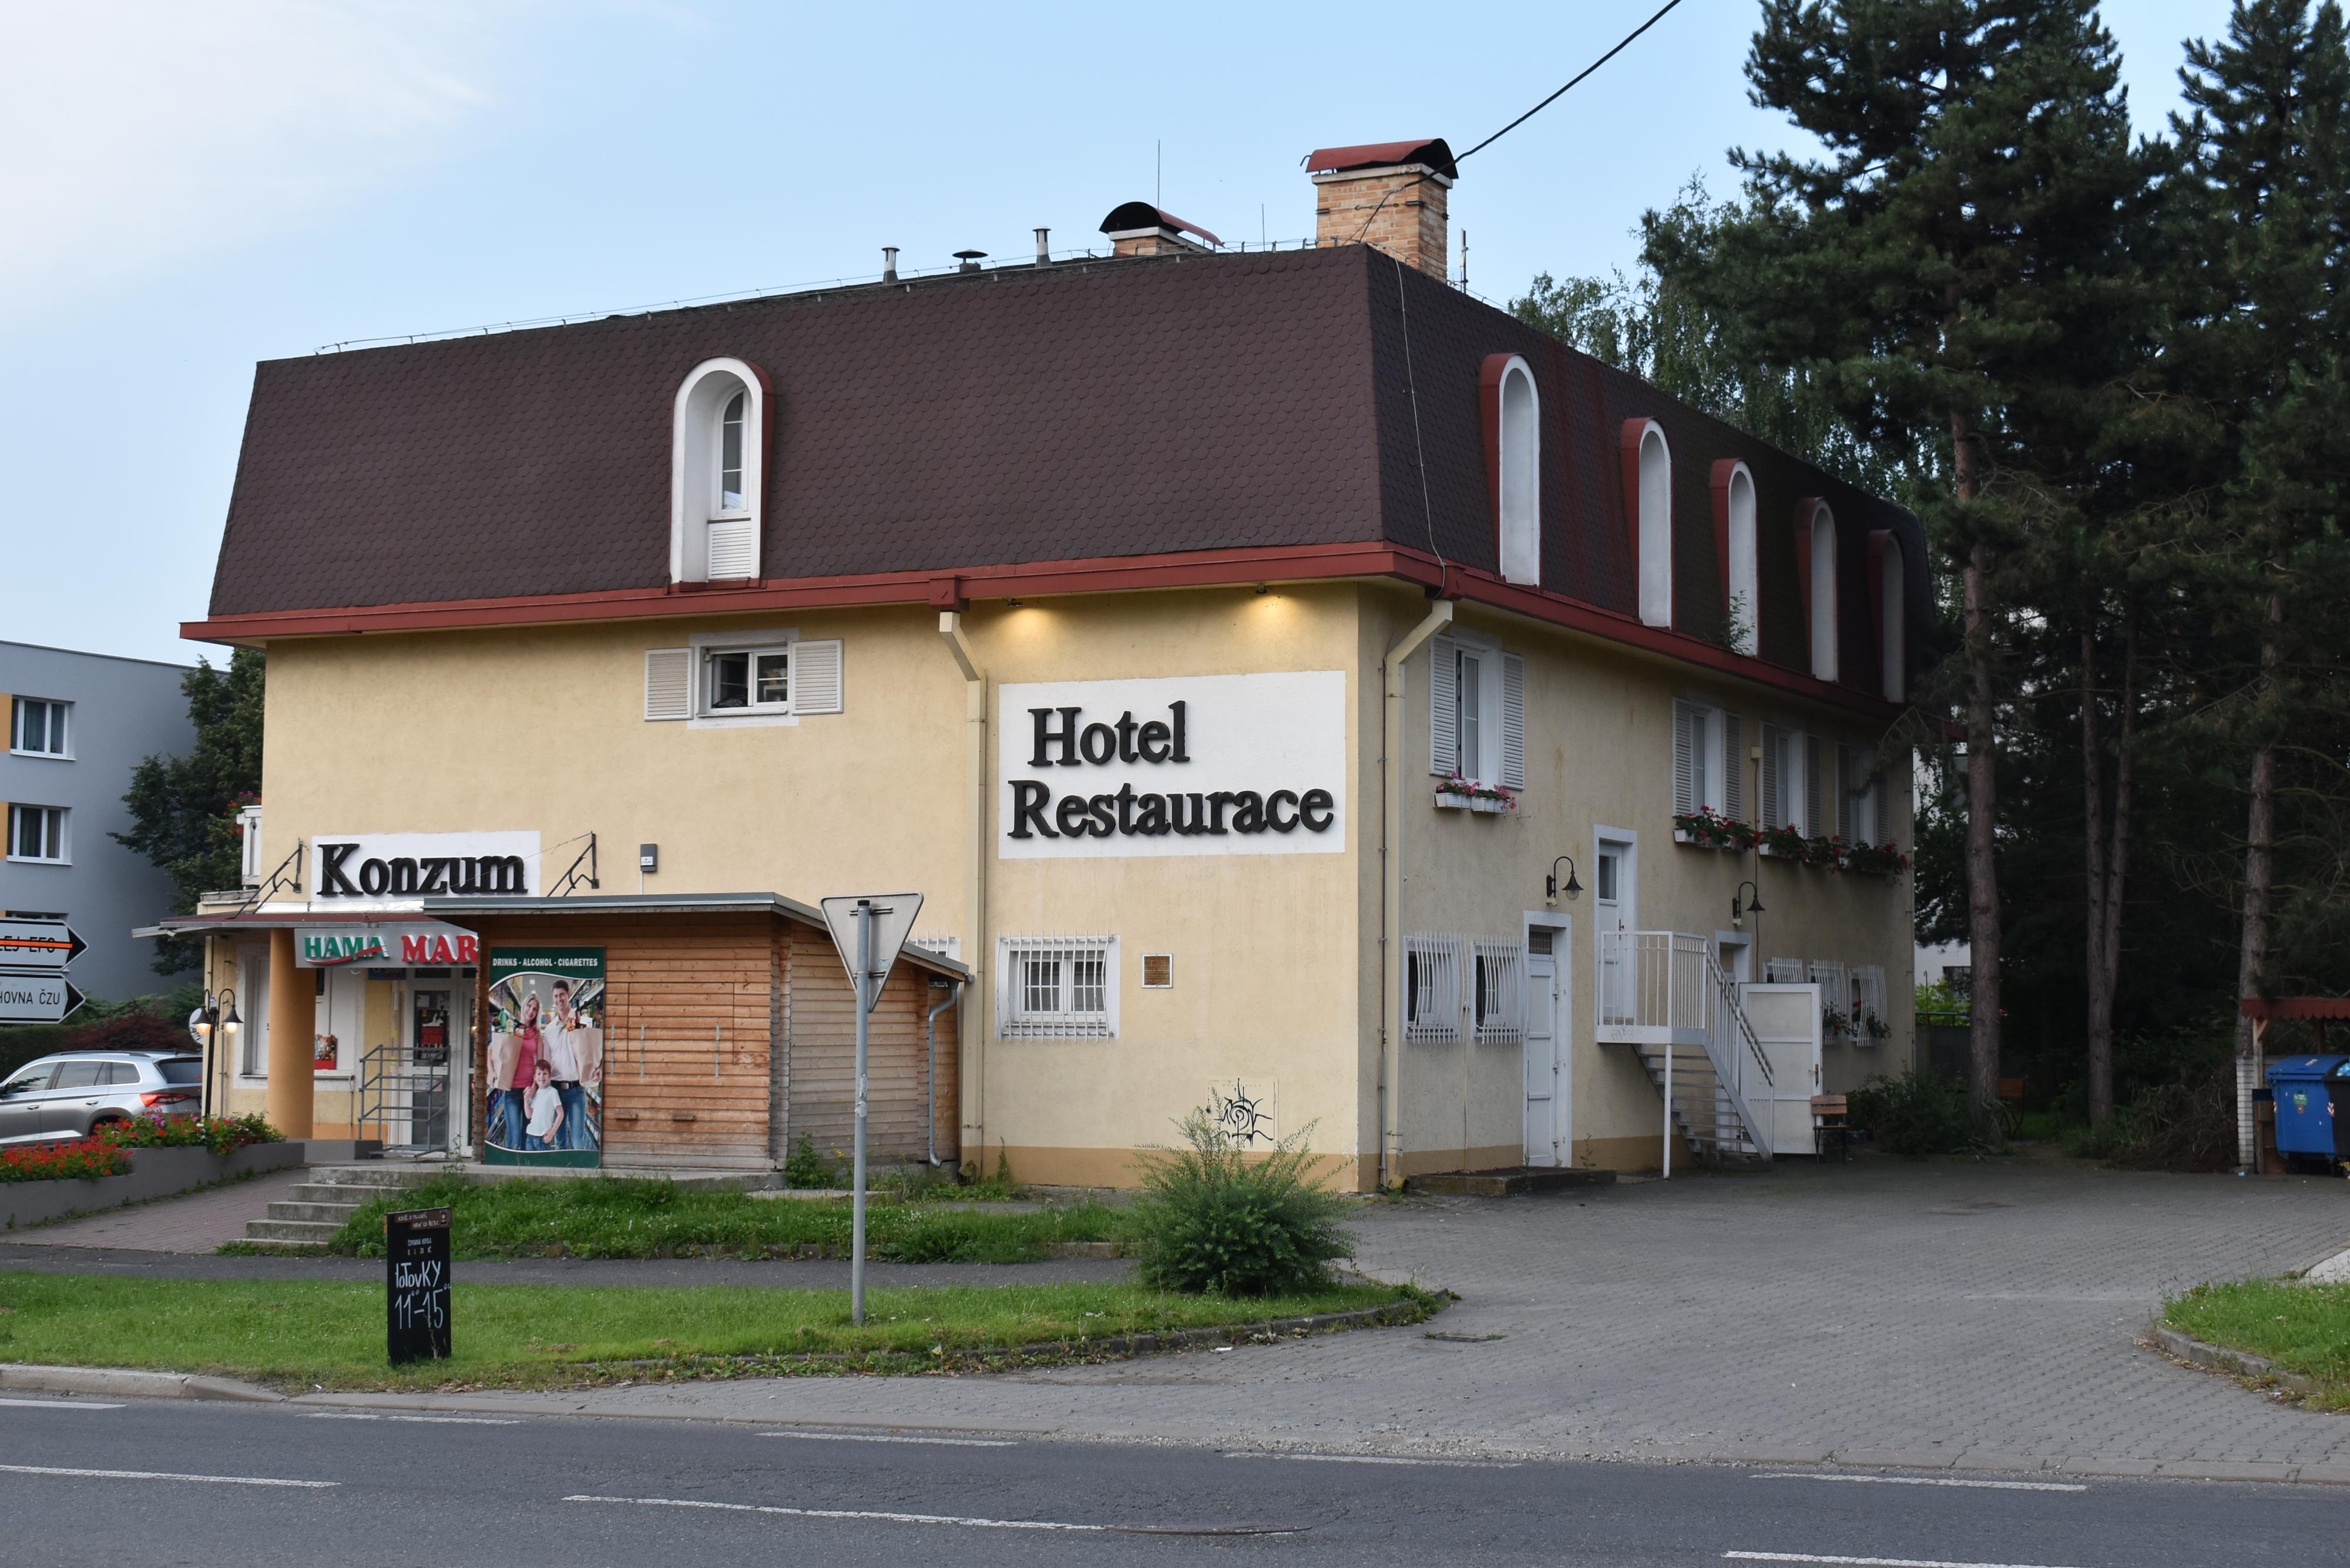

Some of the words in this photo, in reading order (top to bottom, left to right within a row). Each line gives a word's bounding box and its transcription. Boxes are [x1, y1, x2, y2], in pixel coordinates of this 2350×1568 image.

[1028, 700, 1191, 766] Hotel
[1007, 780, 1334, 839] Restaurace
[317, 843, 528, 895] Konzum
[304, 936, 389, 958] HAMA
[493, 958, 518, 966] DRINKS
[522, 958, 553, 966] ALCOHOL
[558, 958, 598, 966] CIGARETTES
[39, 988, 60, 1005] ČZU
